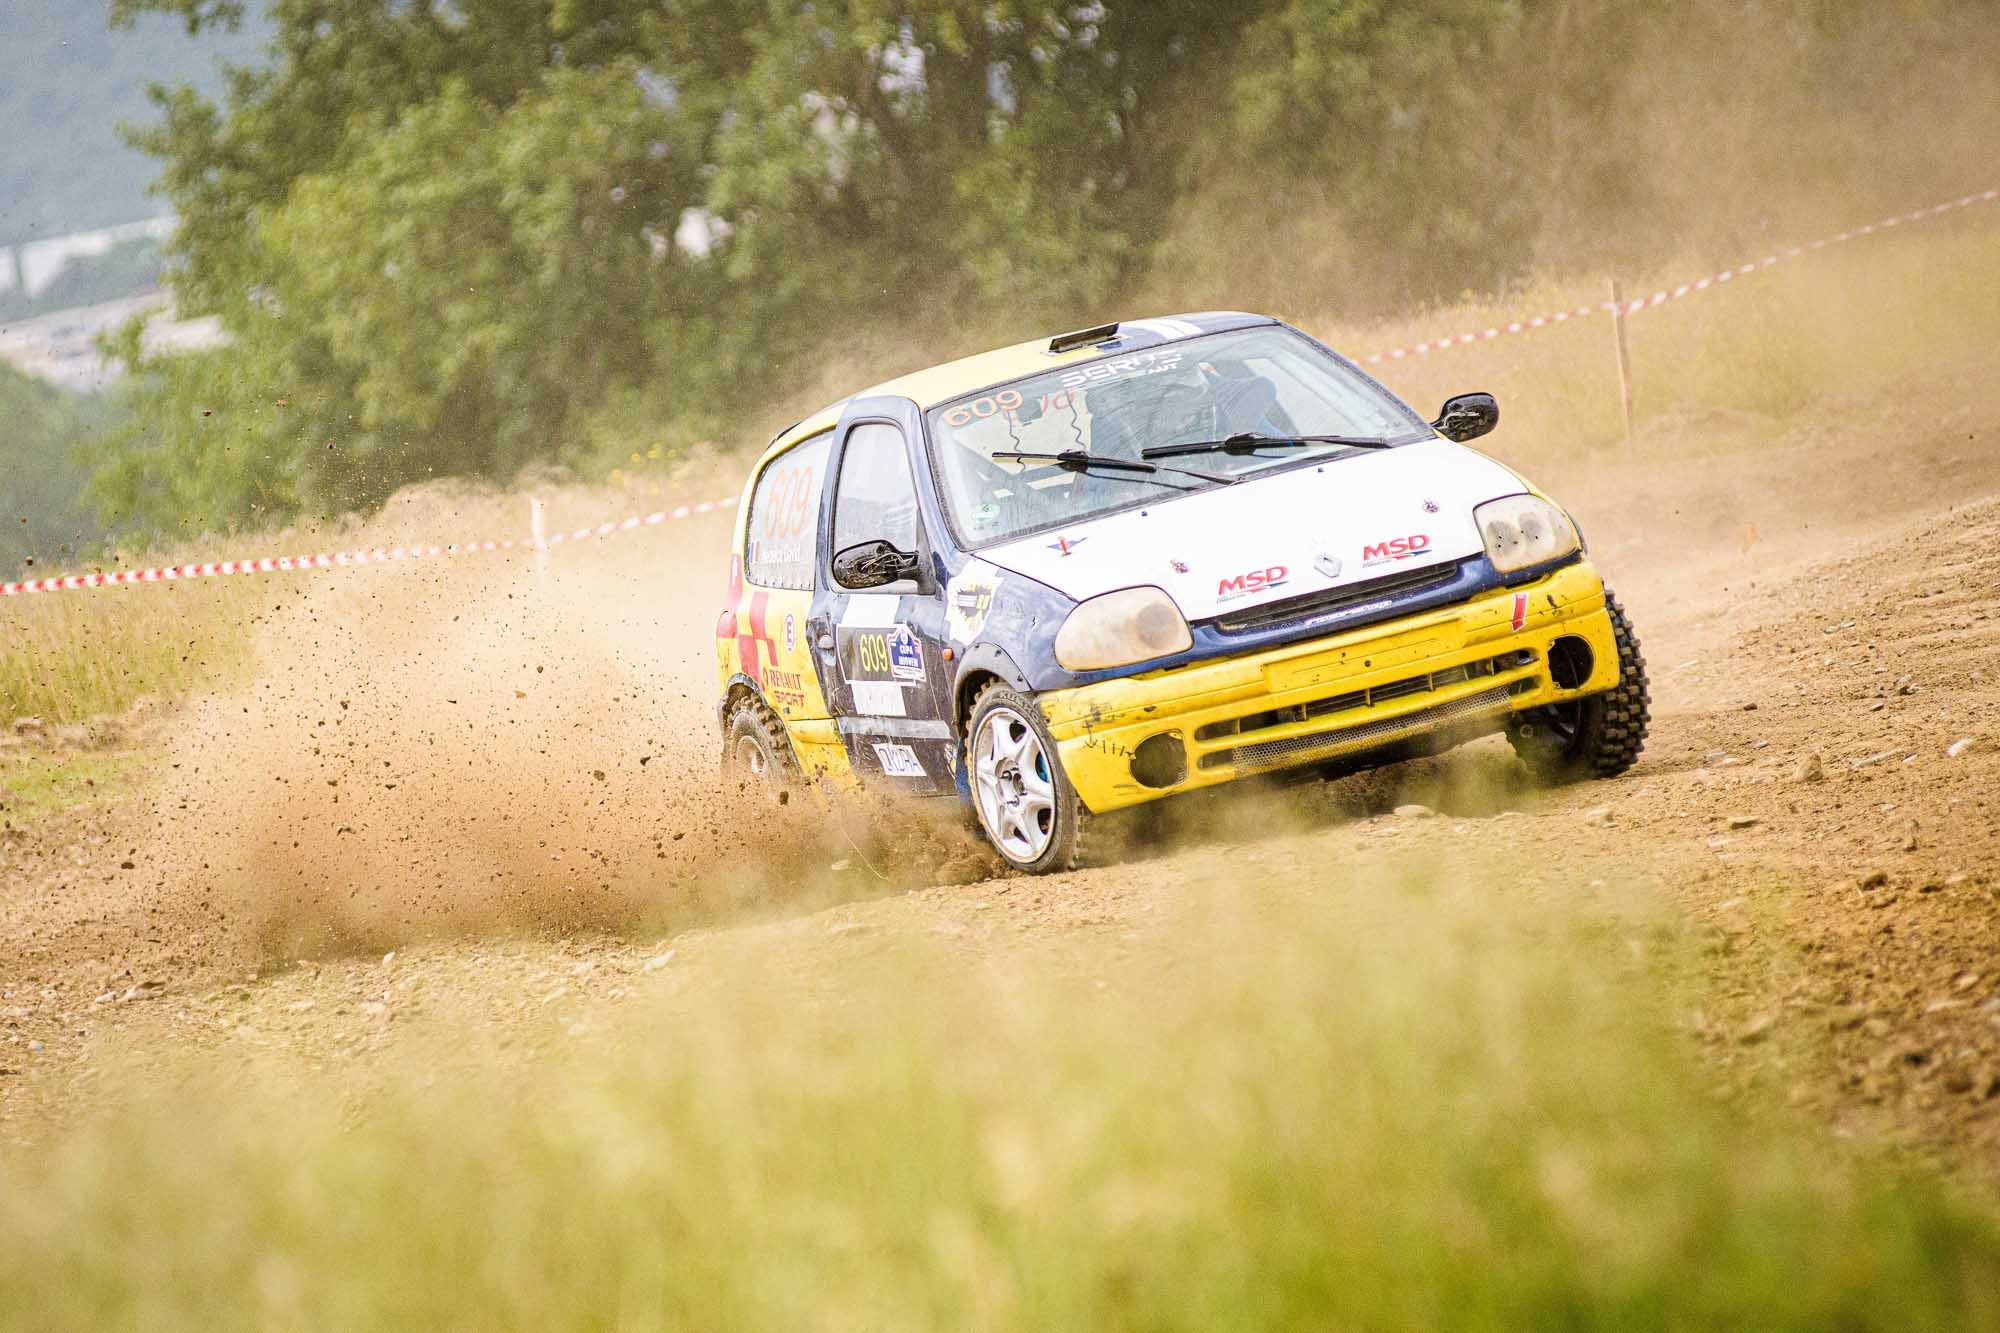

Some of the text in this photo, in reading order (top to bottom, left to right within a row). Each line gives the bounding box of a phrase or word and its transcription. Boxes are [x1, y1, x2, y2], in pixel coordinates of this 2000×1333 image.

[943, 389, 1023, 427] 609
[763, 464, 813, 540] 609
[1362, 534, 1431, 562] MSD
[1217, 565, 1288, 596] MSD
[860, 633, 889, 673] 609
[769, 668, 802, 691] RENAULT
[774, 690, 805, 708] SPORT
